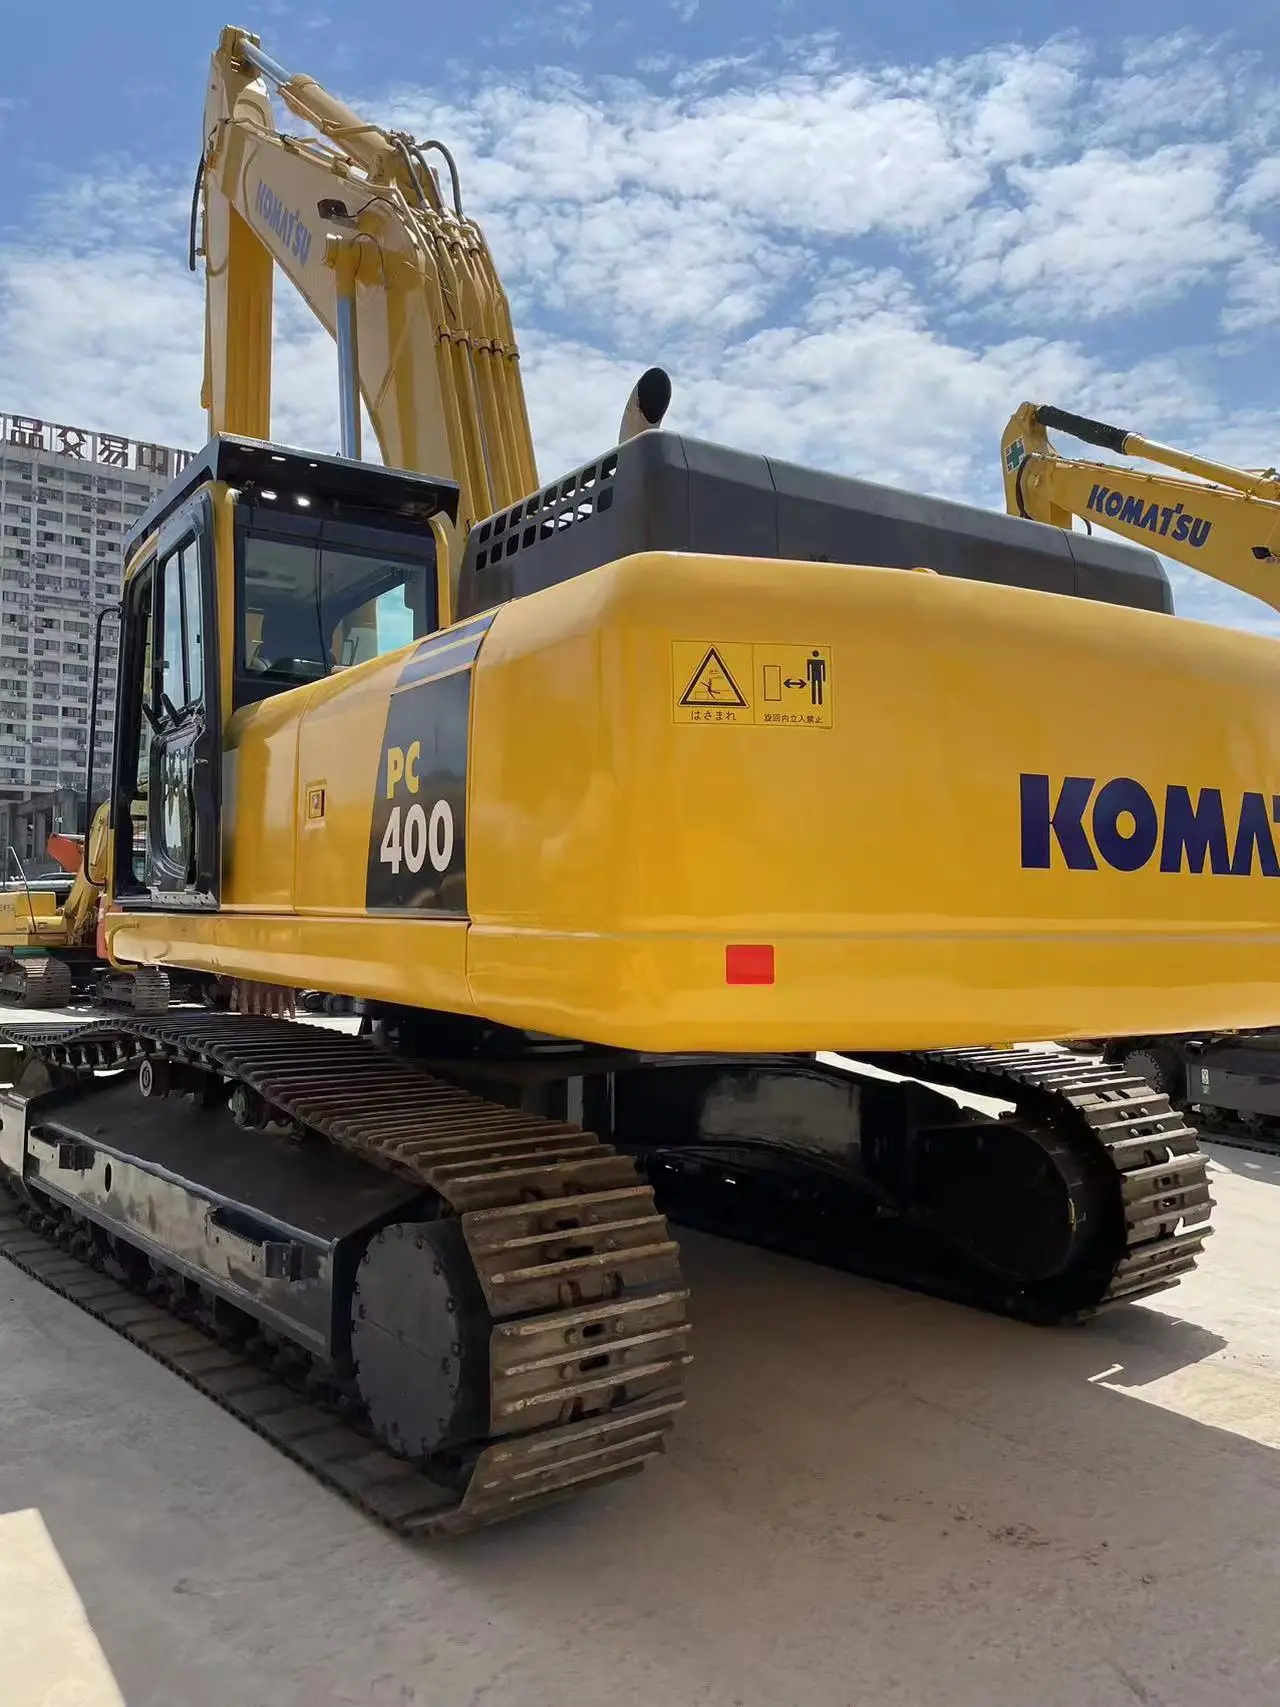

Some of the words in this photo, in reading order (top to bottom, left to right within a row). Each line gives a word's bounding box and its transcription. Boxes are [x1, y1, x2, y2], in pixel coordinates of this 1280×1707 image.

[256, 178, 312, 268] KOMATSU
[1086, 484, 1212, 547] KOMATSU
[691, 710, 736, 721] はさまれ
[764, 713, 823, 725] 旋回内立入禁止
[386, 740, 421, 799] PC
[380, 799, 454, 874] 400
[1020, 773, 1280, 878] KOMA
